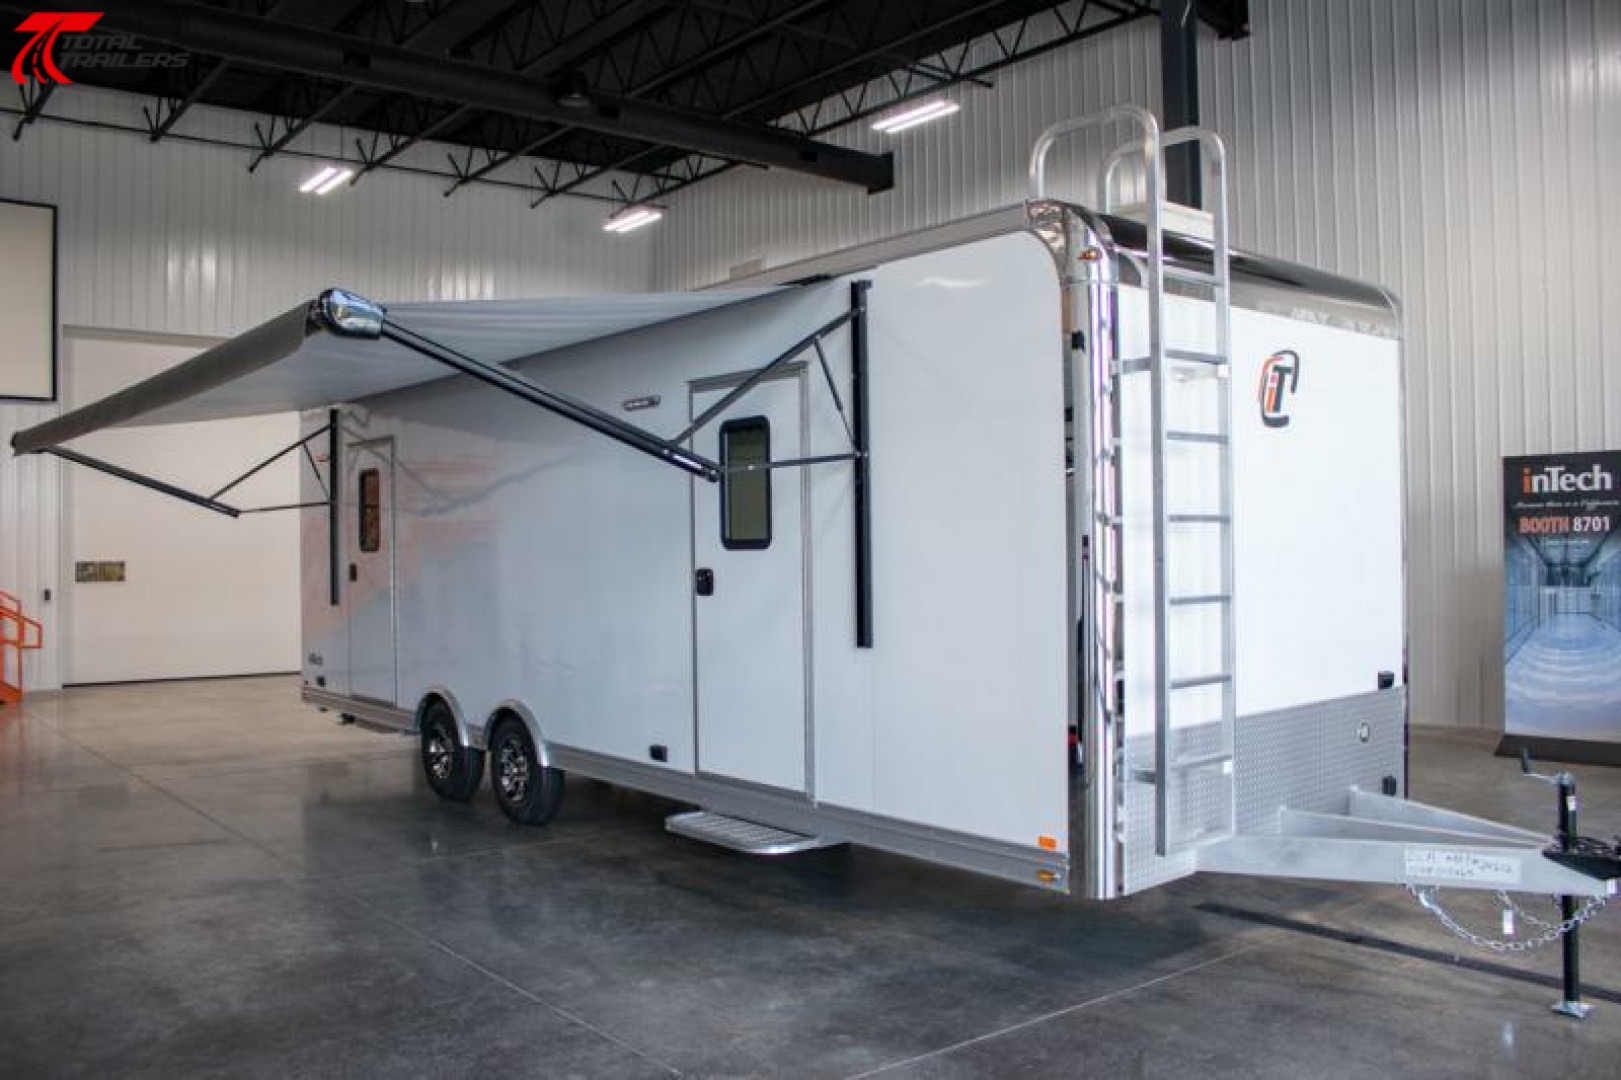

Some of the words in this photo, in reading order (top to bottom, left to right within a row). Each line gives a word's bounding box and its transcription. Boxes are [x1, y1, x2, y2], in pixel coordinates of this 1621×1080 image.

[1523, 464, 1612, 493] inTech
[1519, 517, 1570, 534] BOOTH
[1573, 516, 1610, 532] 8701
